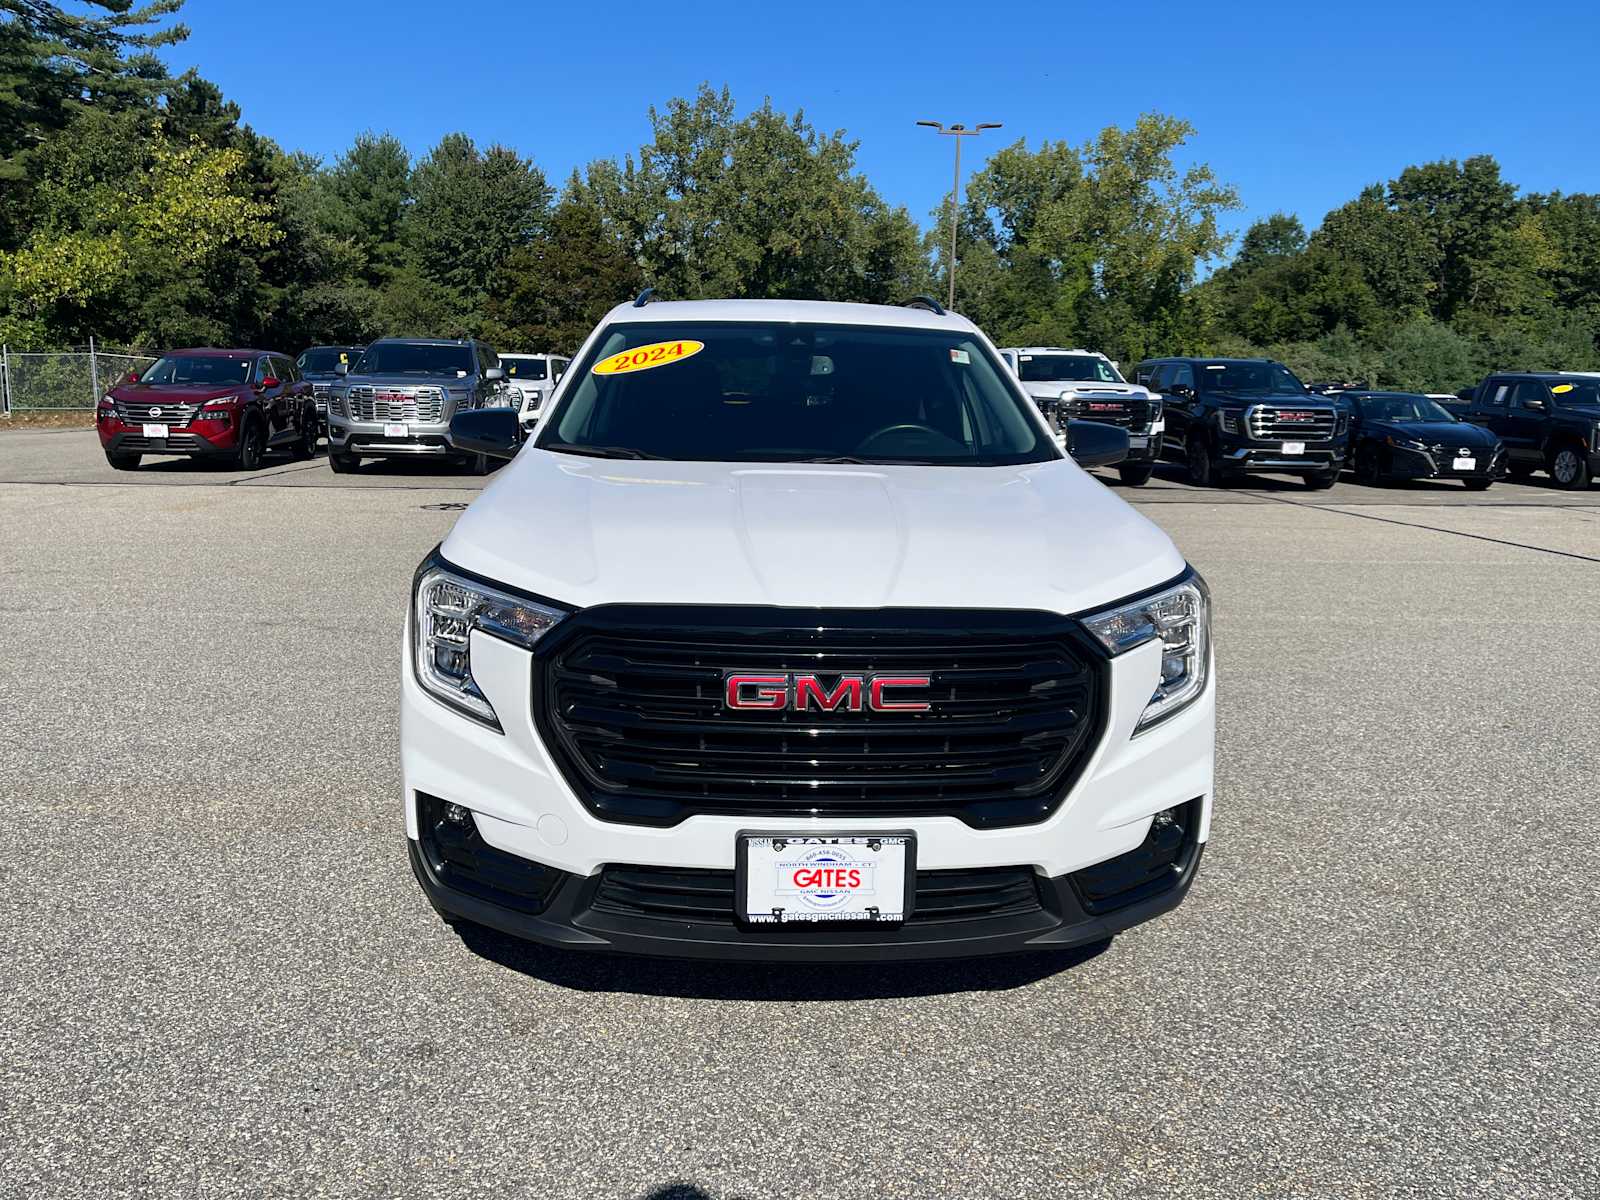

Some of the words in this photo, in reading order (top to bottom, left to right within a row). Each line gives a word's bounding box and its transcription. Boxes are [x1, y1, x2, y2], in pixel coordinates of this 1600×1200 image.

[614, 343, 684, 371] 2024
[725, 673, 931, 712] GMC
[786, 837, 869, 845] GATES
[880, 838, 905, 846] GMC
[793, 868, 861, 888] GATES
